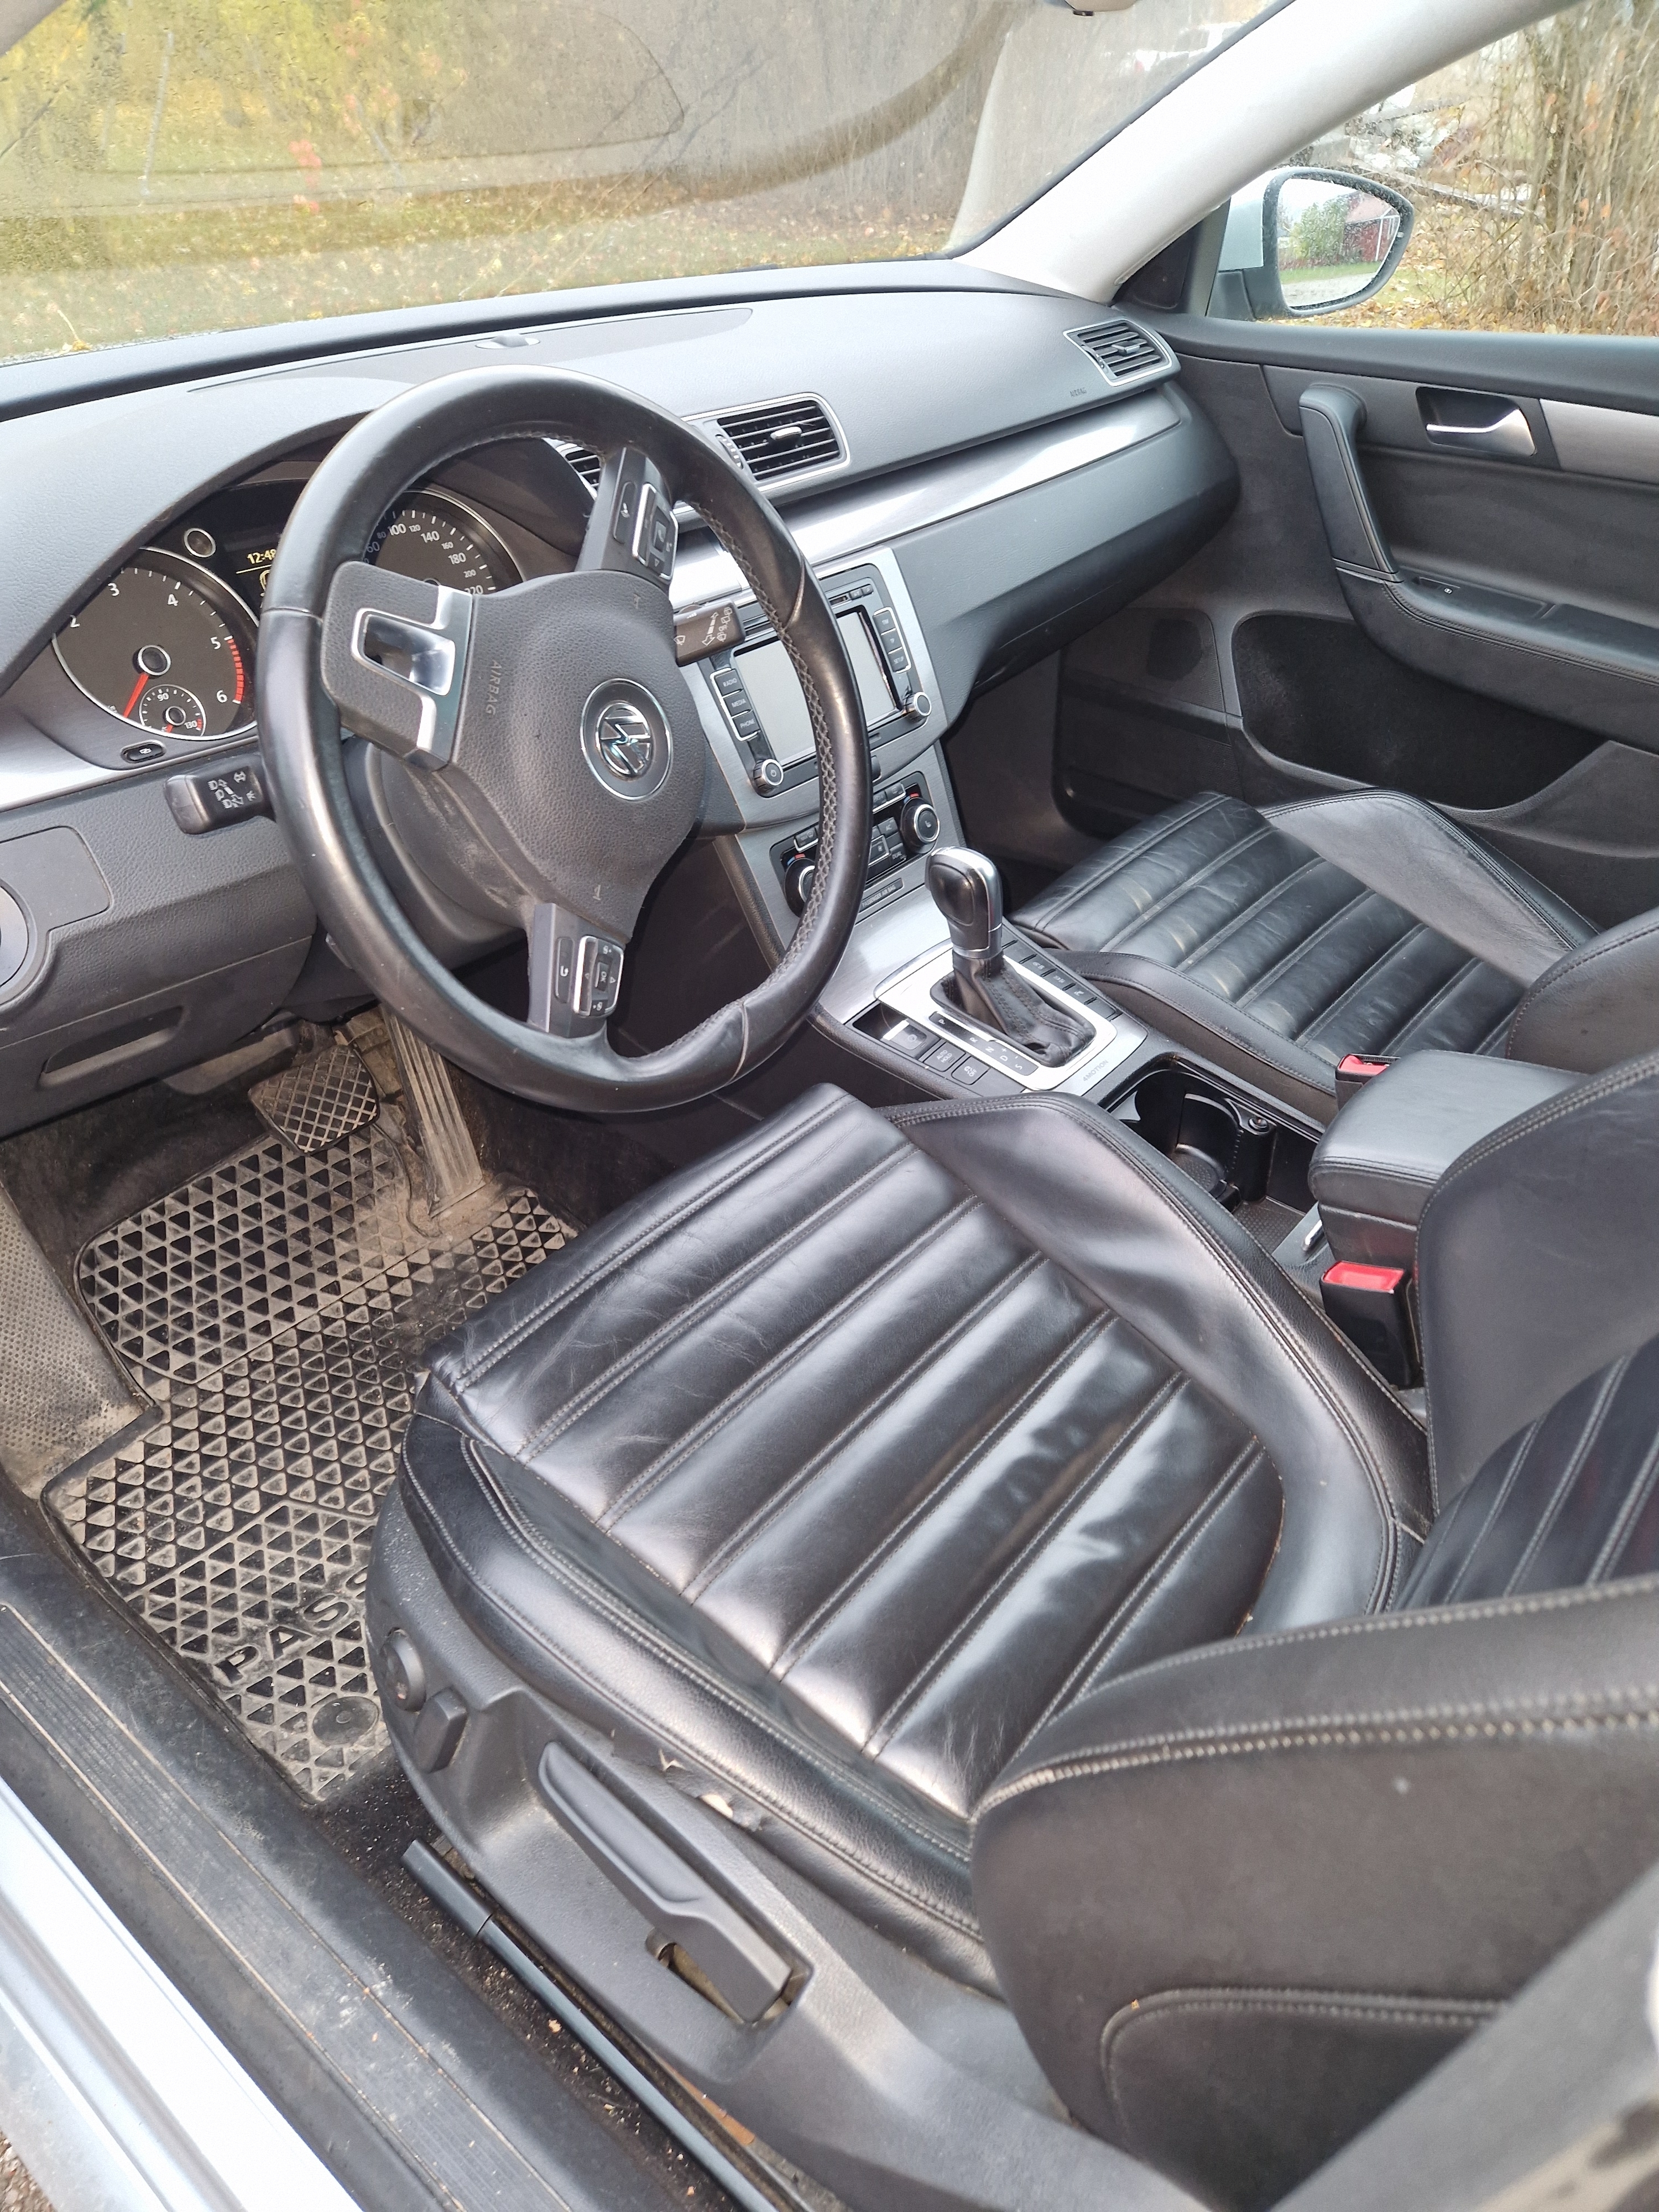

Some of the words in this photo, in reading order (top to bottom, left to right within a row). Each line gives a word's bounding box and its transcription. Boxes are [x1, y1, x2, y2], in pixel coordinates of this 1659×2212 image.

[388, 523, 406, 536] 100
[420, 530, 440, 543] 140
[441, 541, 453, 550] 160
[447, 552, 466, 565] 180
[463, 569, 476, 578] 200
[107, 582, 120, 596] 3
[167, 593, 179, 607] 4
[70, 614, 80, 628] 2
[210, 636, 221, 650] 5
[486, 659, 502, 716] AIRBAG
[723, 677, 738, 687] RADIO
[157, 692, 169, 702] 90
[216, 690, 228, 703] 6
[731, 698, 747, 708] MEDIA
[740, 718, 755, 729] PHONE
[600, 971, 607, 983] OK
[936, 1050, 947, 1060] AUTO
[941, 1052, 952, 1063] HOLD
[1083, 1059, 1109, 1082] 4MOTION
